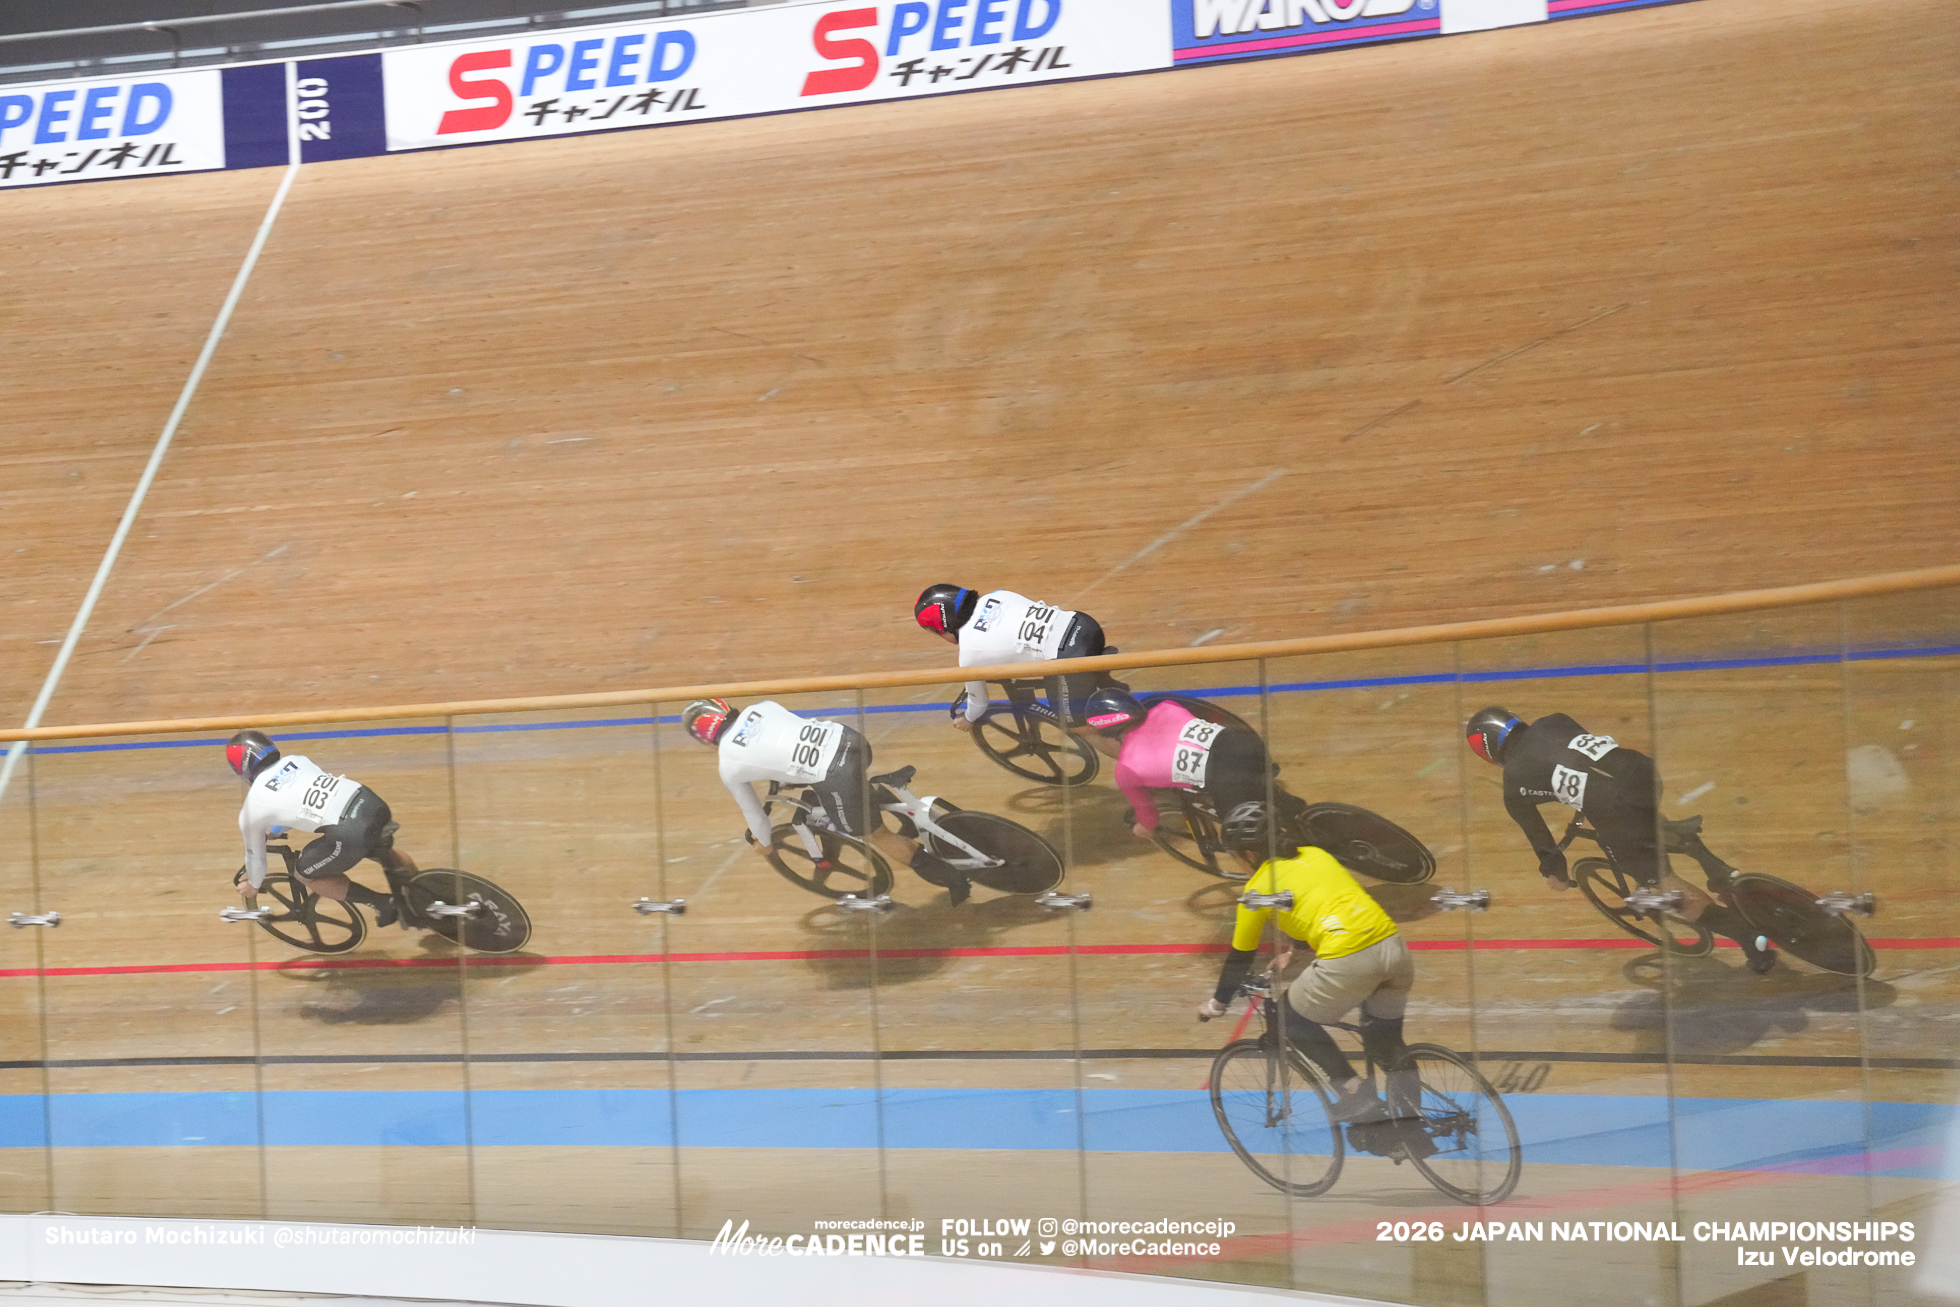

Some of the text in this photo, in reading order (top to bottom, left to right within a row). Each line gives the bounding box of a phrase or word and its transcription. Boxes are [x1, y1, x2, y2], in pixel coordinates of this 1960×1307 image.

[799, 0, 1061, 97] SPEED
[888, 46, 1073, 87] チャンネル
[436, 29, 697, 135] SPEED
[298, 77, 331, 141] 200
[524, 88, 706, 126] チャンネル
[0, 142, 184, 179] チャンネル
[1018, 621, 1046, 644] 104
[792, 743, 820, 767] 100
[1176, 749, 1204, 774] 87
[302, 788, 328, 810] 103
[1557, 770, 1580, 797] 78
